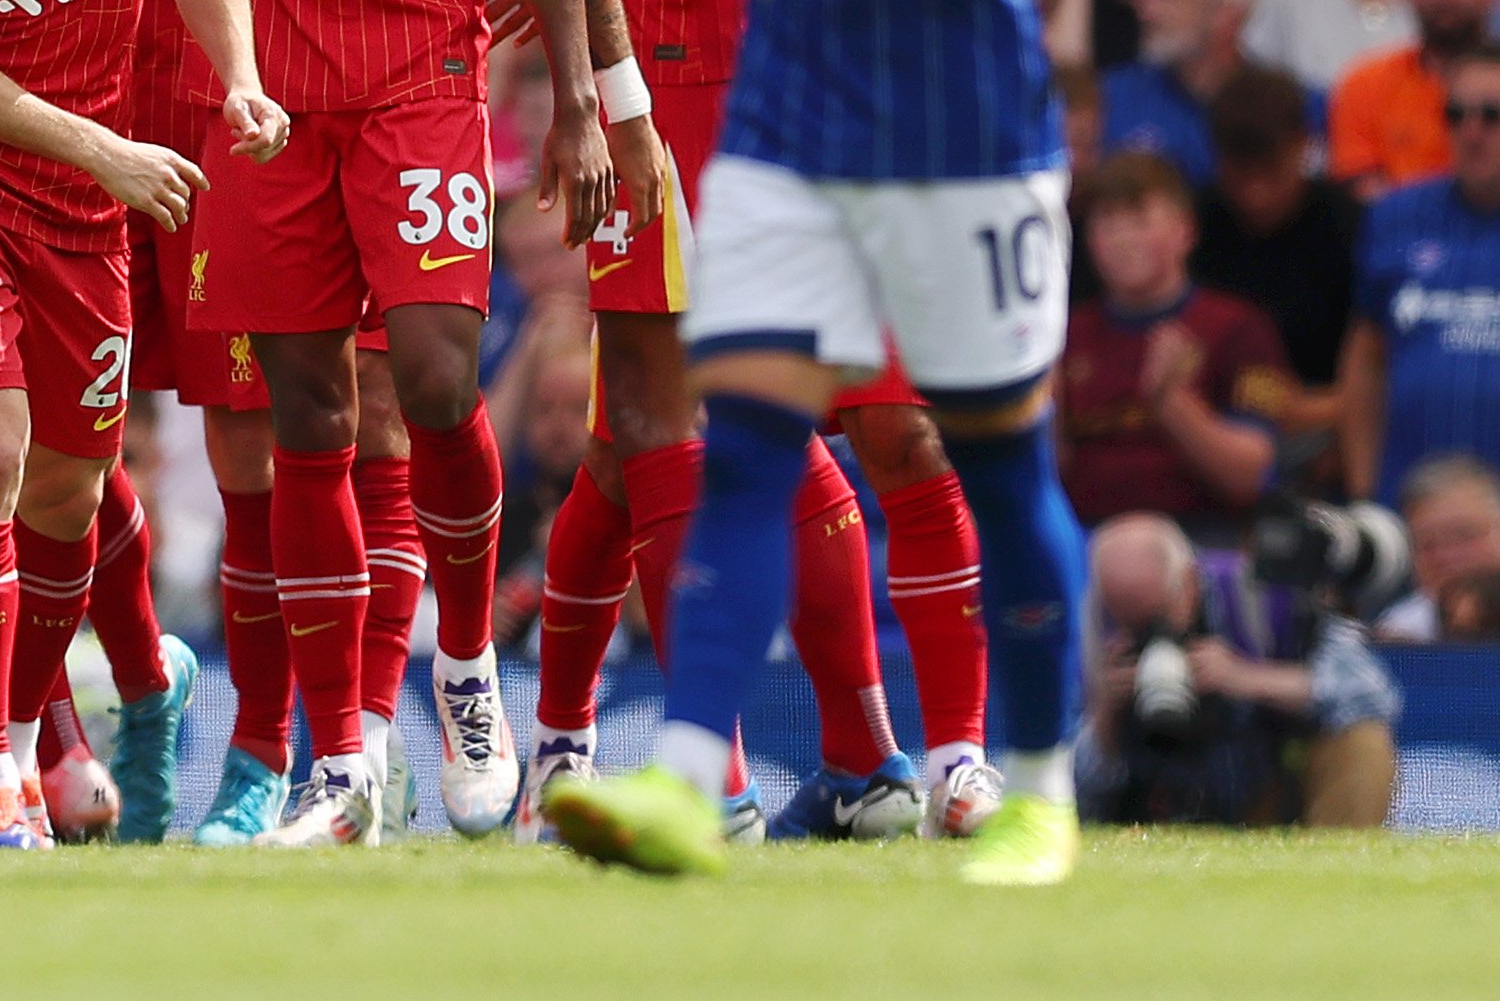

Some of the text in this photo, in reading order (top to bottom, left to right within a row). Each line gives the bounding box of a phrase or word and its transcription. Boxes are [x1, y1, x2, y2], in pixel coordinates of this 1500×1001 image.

[397, 168, 488, 249] 38
[592, 210, 634, 255] 4
[976, 213, 1048, 311] 10
[188, 289, 206, 302] LFC
[231, 370, 253, 382] LFC
[824, 508, 861, 537] LFC
[32, 614, 74, 628] LFC
